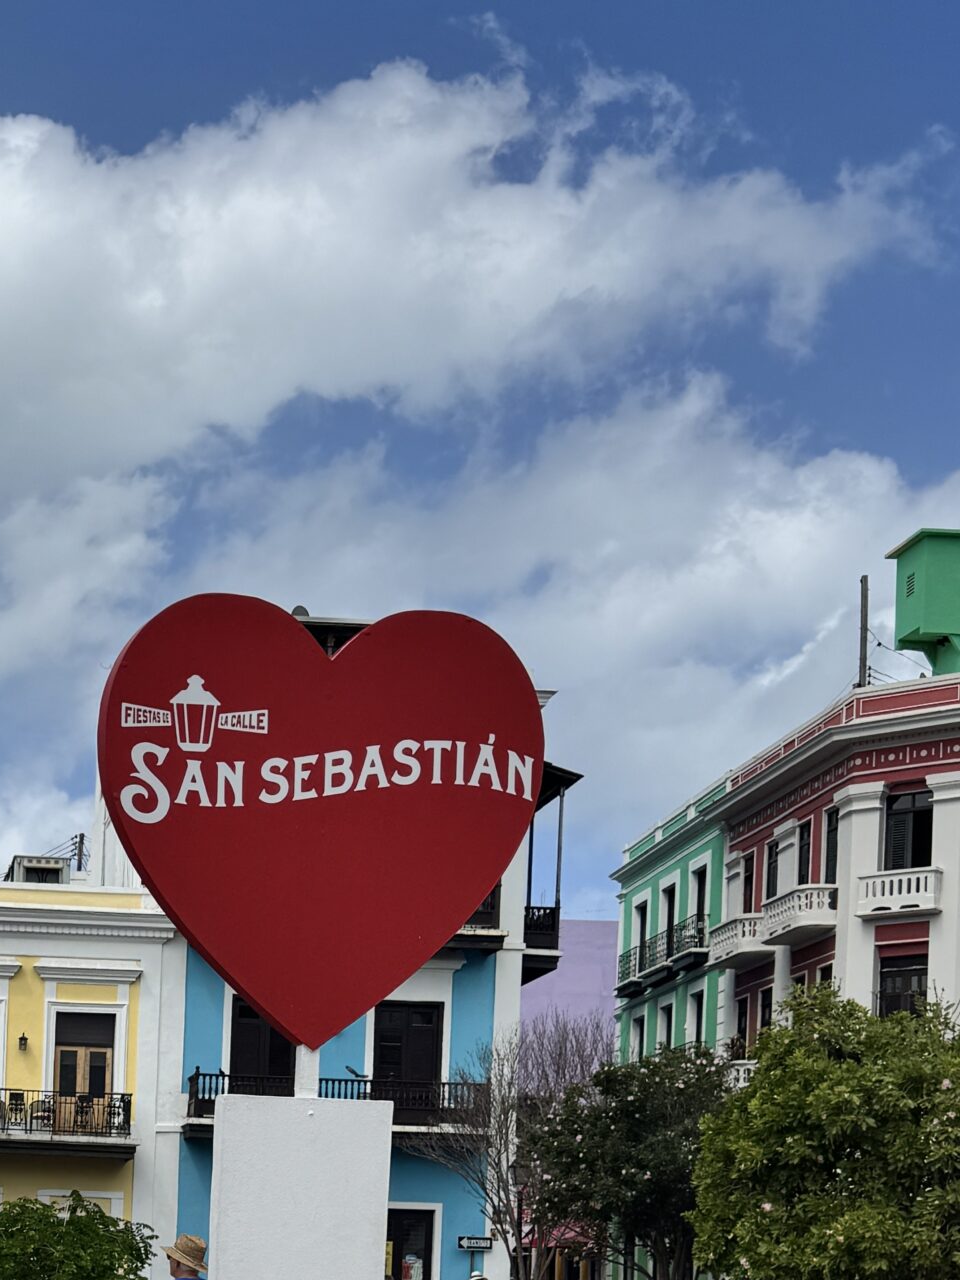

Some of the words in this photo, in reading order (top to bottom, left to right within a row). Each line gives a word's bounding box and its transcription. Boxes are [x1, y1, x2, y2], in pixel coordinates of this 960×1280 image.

[124, 706, 161, 724] FIESTAS
[162, 712, 169, 723] DE
[220, 716, 229, 727] LA
[230, 712, 265, 730] CALLE
[120, 742, 246, 824] SAN
[258, 734, 536, 804] SEBASTIÁN
